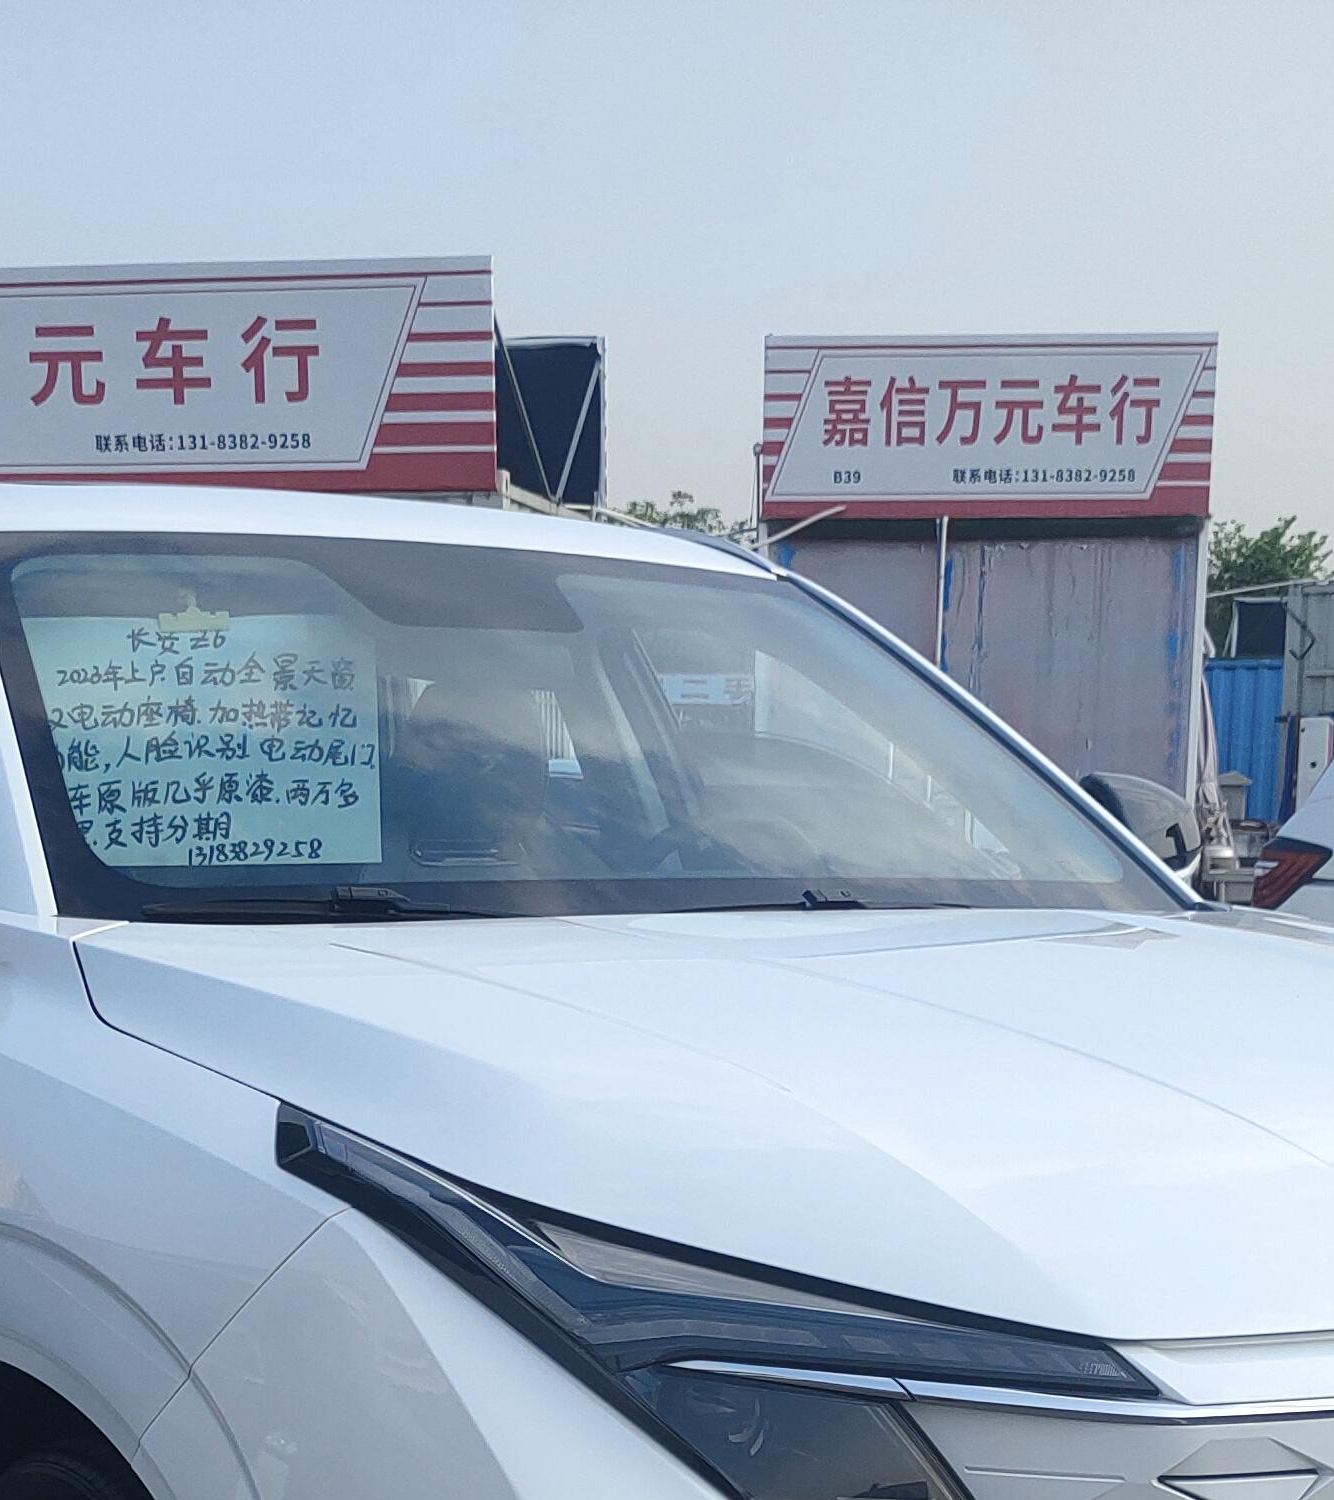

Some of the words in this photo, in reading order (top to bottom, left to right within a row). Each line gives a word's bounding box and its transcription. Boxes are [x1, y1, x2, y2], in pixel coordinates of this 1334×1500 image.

[822, 373, 1162, 449] 嘉信万元车行
[833, 469, 862, 485] B39
[188, 838, 324, 869] 13183829258
